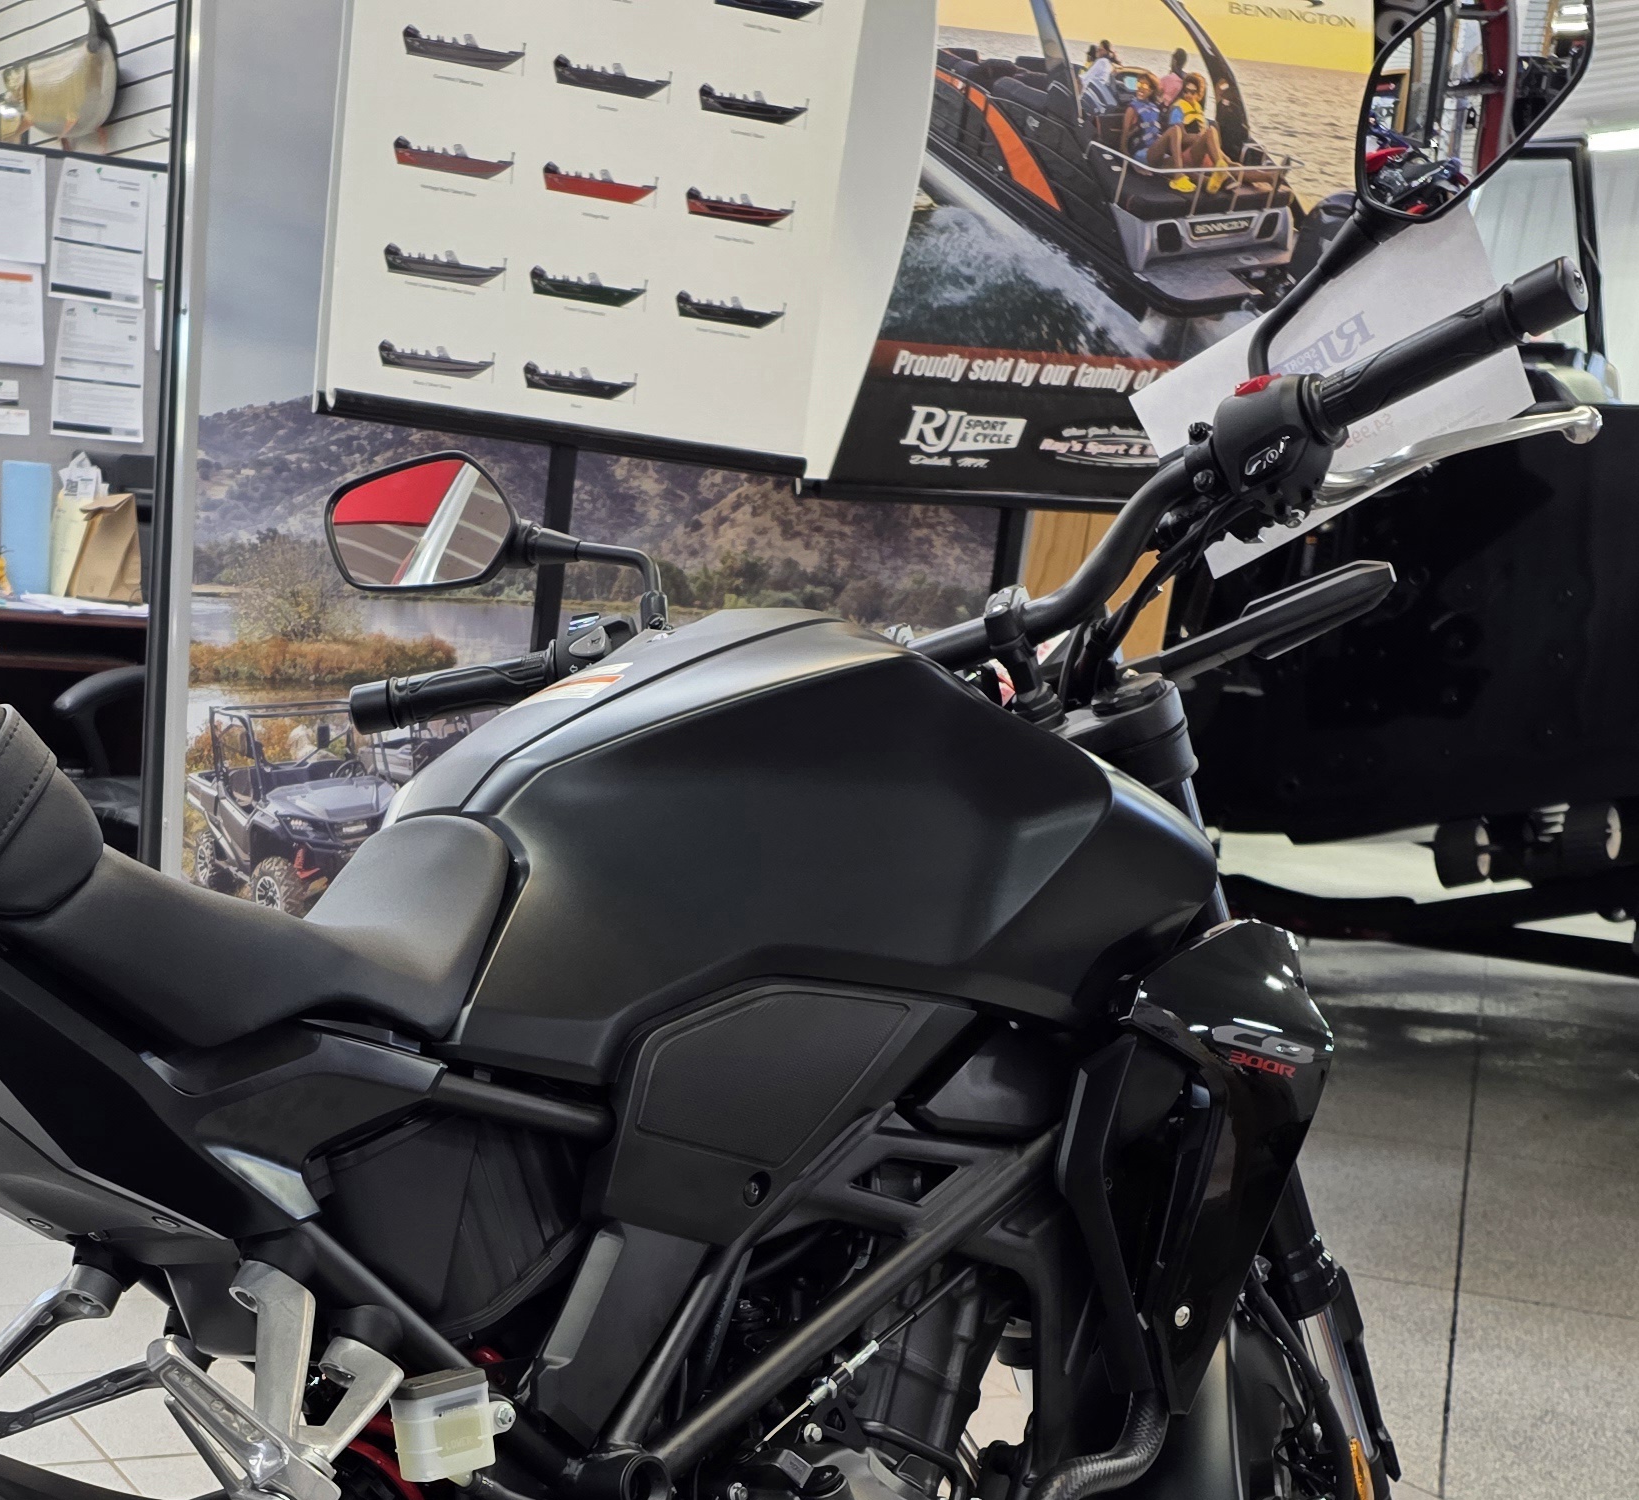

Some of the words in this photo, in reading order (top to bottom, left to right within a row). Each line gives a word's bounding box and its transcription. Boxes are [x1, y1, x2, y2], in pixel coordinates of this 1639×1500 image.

[1228, 2, 1356, 28] BENNINGTON
[892, 350, 969, 382] Proudly
[968, 356, 1014, 382] sold
[1012, 358, 1041, 387] by
[1039, 362, 1076, 386] our
[1073, 362, 1136, 392] family
[899, 405, 968, 453] RJ
[959, 431, 969, 442] &
[973, 432, 1013, 444] CYCLE
[964, 419, 1007, 431] SPORT
[1212, 1025, 1315, 1063] CB
[1229, 1049, 1297, 1078] 300R
